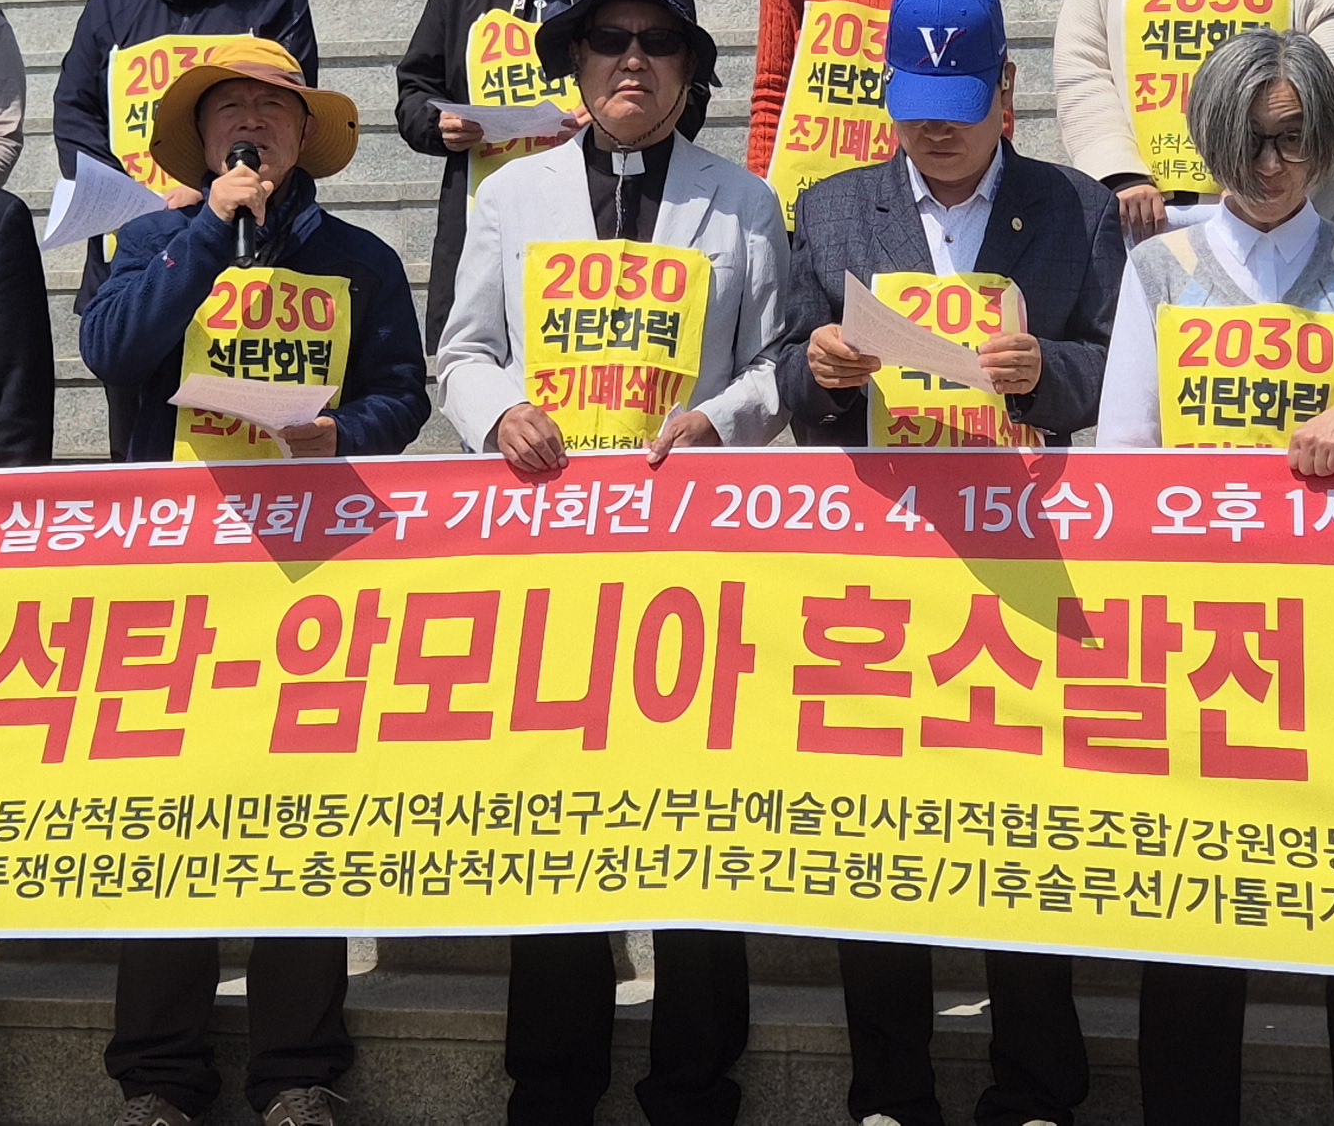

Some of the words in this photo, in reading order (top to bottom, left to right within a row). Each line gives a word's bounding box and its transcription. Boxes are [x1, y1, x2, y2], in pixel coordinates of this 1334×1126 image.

[481, 21, 531, 63] 20
[810, 12, 888, 62] 203
[1141, 19, 1271, 61] 석탄화
[807, 61, 887, 109] 석탄화
[785, 114, 899, 162] 조기폐쇄
[542, 252, 688, 303] 2030
[207, 280, 336, 332] 2030
[899, 284, 1002, 335] 203
[540, 306, 681, 359] 석탄화력
[1178, 317, 1334, 374] 2030
[207, 337, 333, 386] 석탄화력
[1177, 376, 1331, 432] 석탄화력
[0, 495, 195, 553] 실증사업
[212, 491, 311, 544] 철회
[325, 491, 429, 541] 요구
[444, 479, 651, 539] 기자회견
[669, 480, 695, 534] /
[711, 483, 865, 533] 2026.
[886, 484, 936, 533] 4.
[959, 481, 1114, 540] 15(수)
[1151, 482, 1266, 543] 오후
[792, 584, 1309, 783] 혼소발전
